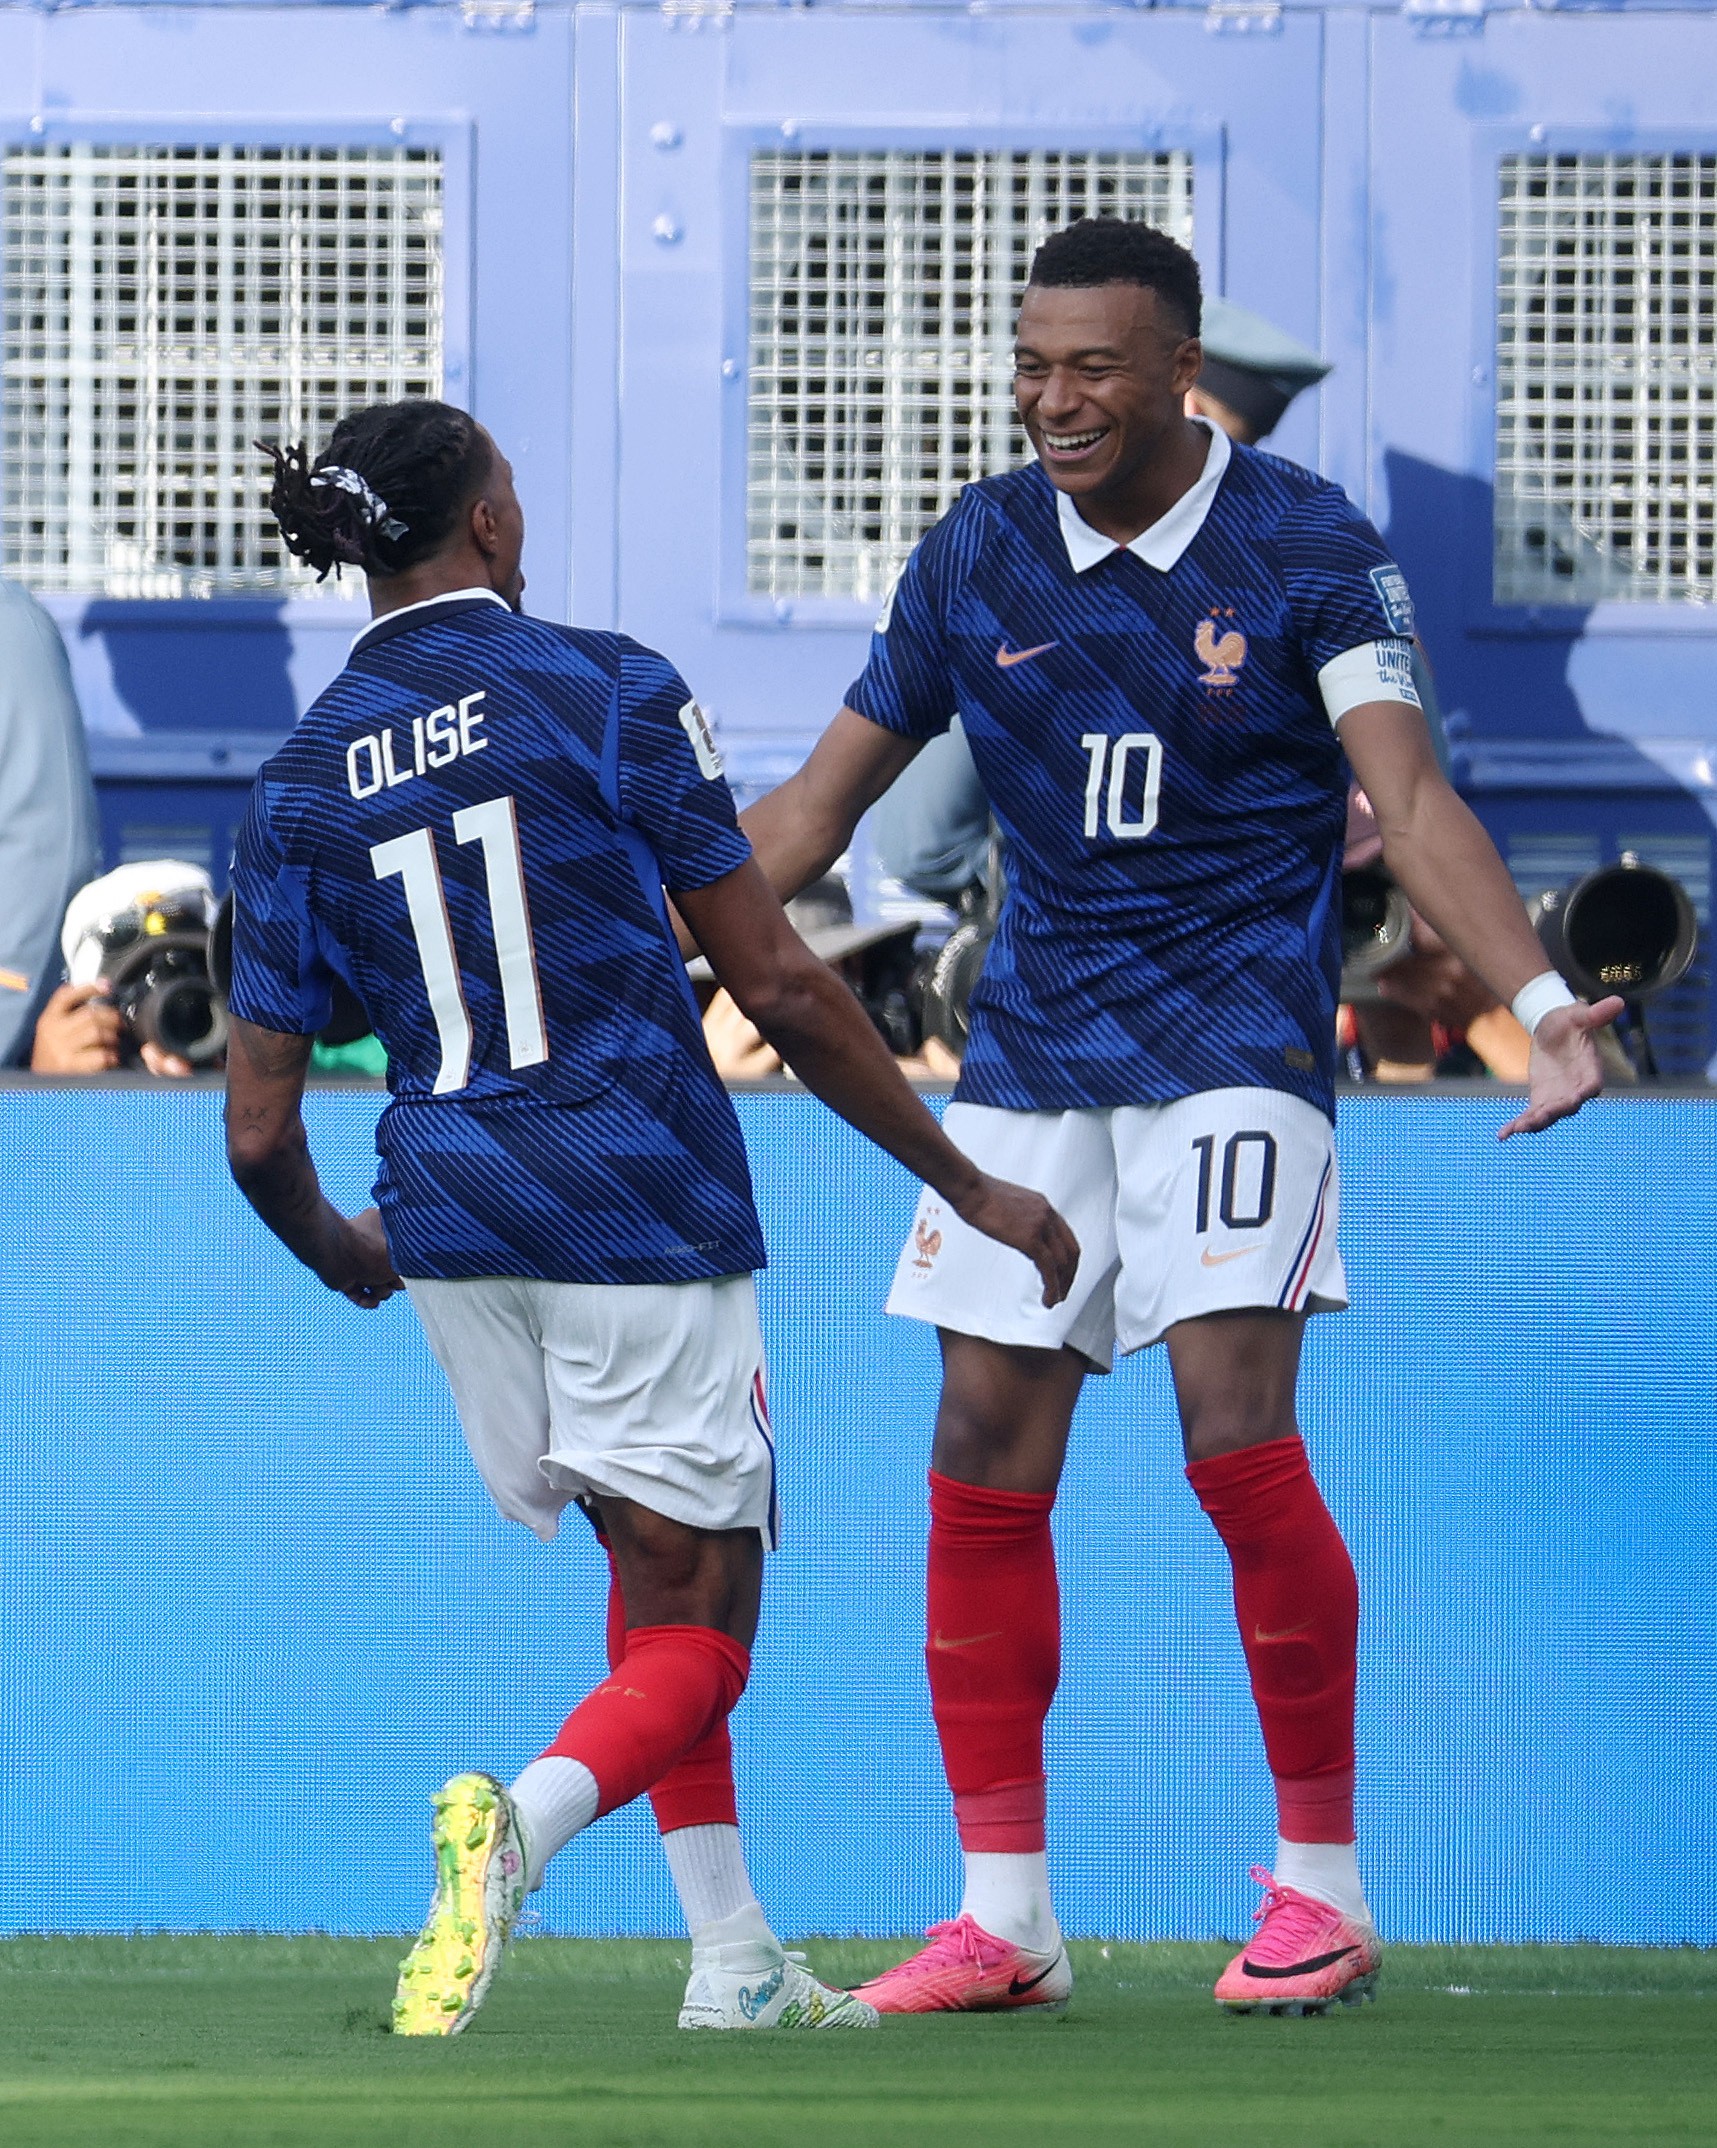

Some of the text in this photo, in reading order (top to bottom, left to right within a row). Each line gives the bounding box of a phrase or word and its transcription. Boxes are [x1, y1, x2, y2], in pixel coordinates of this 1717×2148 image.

[346, 691, 488, 800] OLISE
[1082, 734, 1162, 839] 10
[370, 796, 548, 1095] 11
[1192, 1130, 1276, 1234] 10
